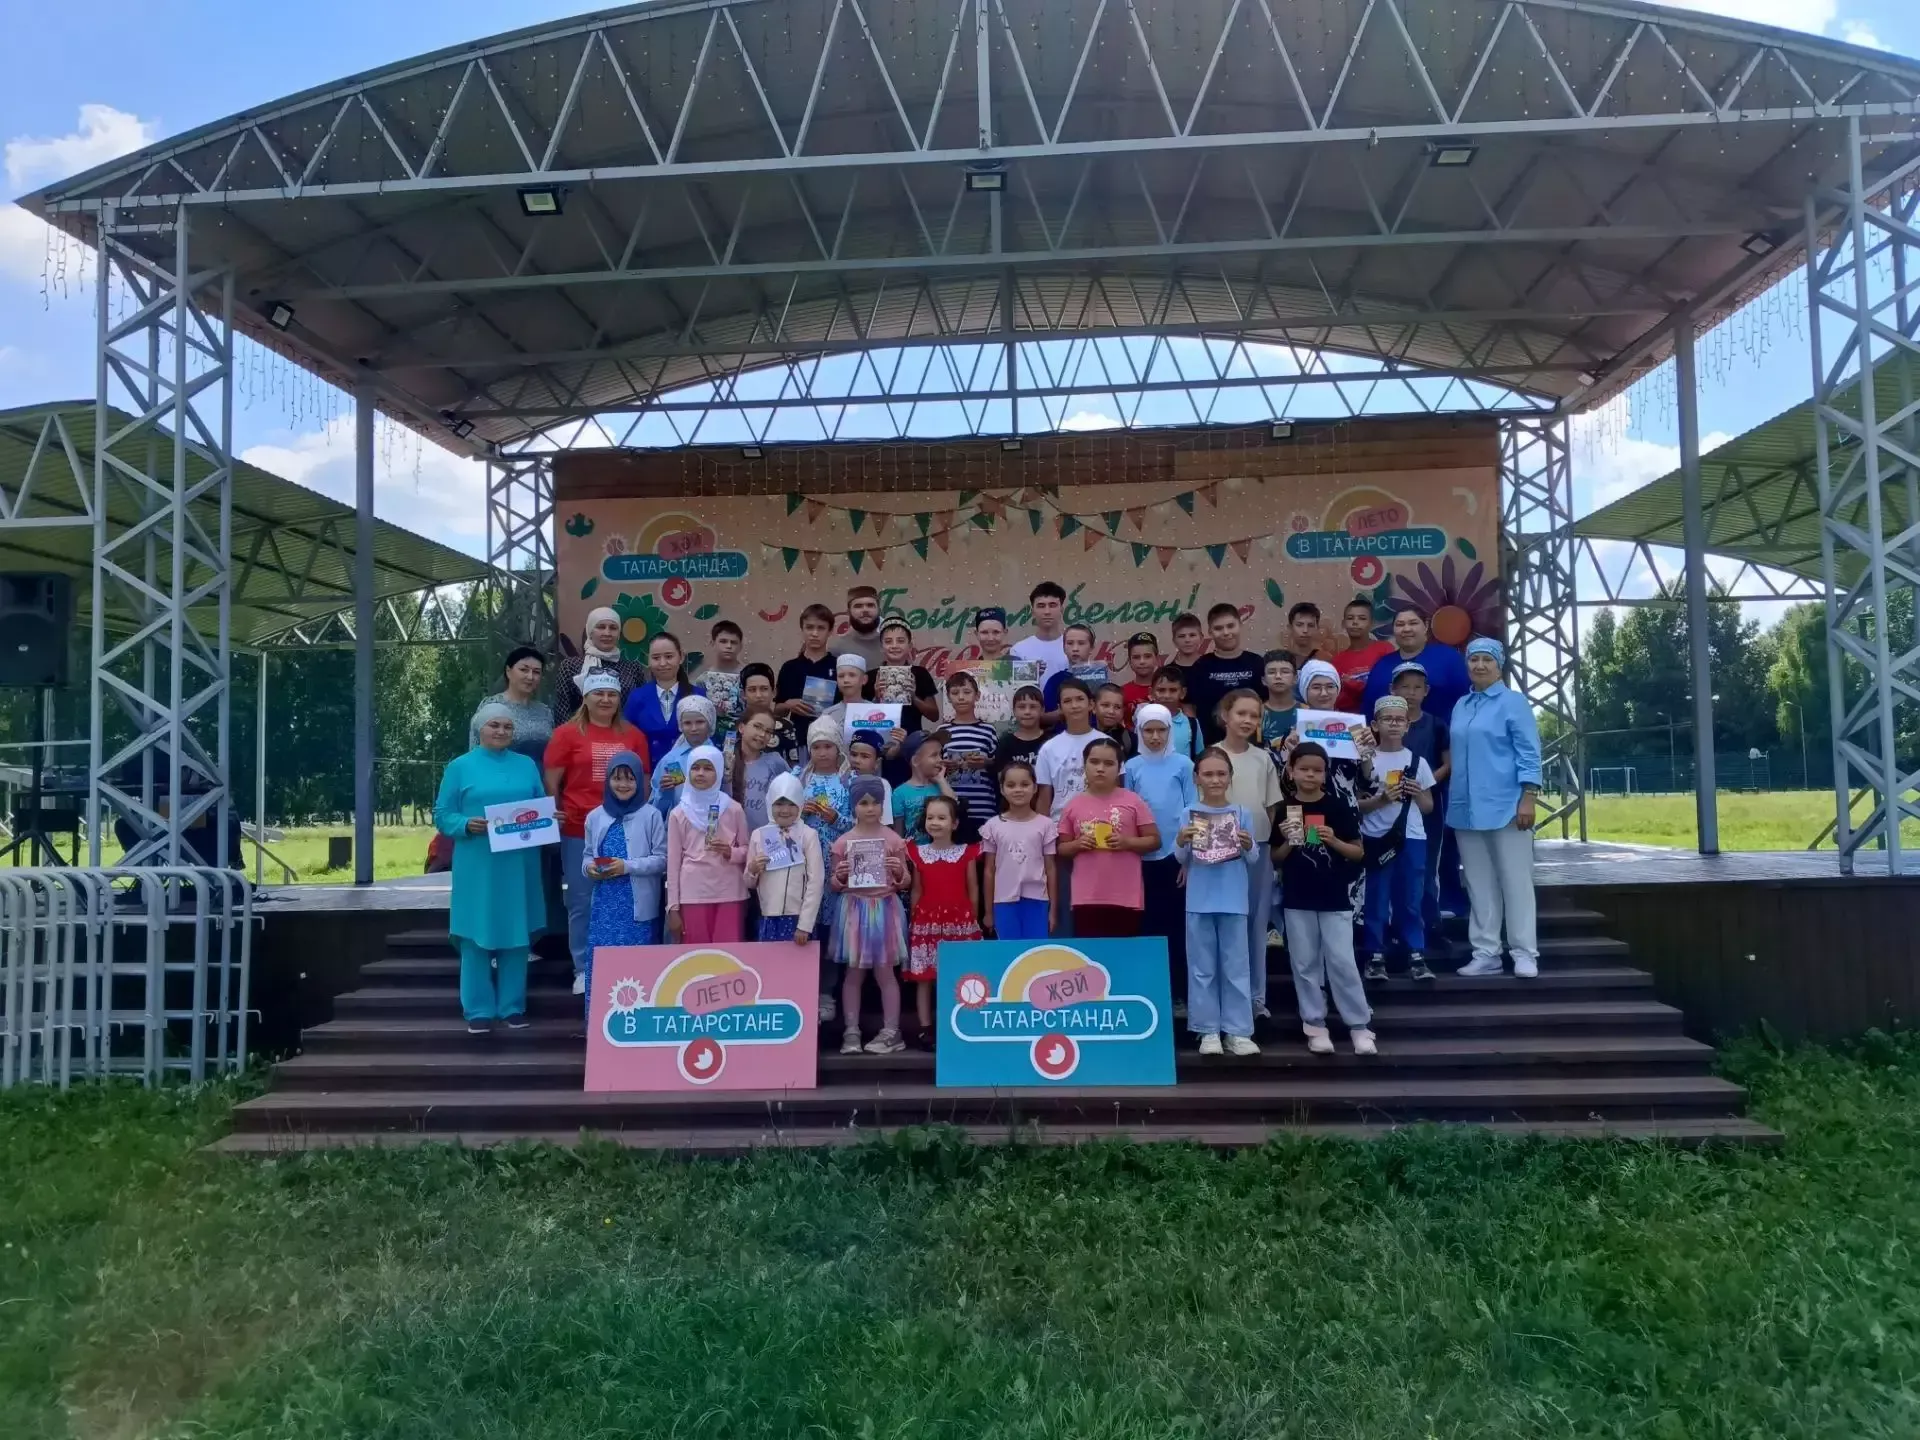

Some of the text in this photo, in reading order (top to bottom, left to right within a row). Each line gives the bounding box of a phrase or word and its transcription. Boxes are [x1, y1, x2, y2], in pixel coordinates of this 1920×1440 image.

[1357, 508, 1400, 530] ЛЕТО
[1323, 534, 1433, 552] ТАТАРСТАНЕ
[696, 978, 746, 1007] ЛЕТО
[625, 1012, 785, 1035] В ТАТАРСТАНЕ
[980, 1008, 1129, 1031] ТАТАРСТАНДА
